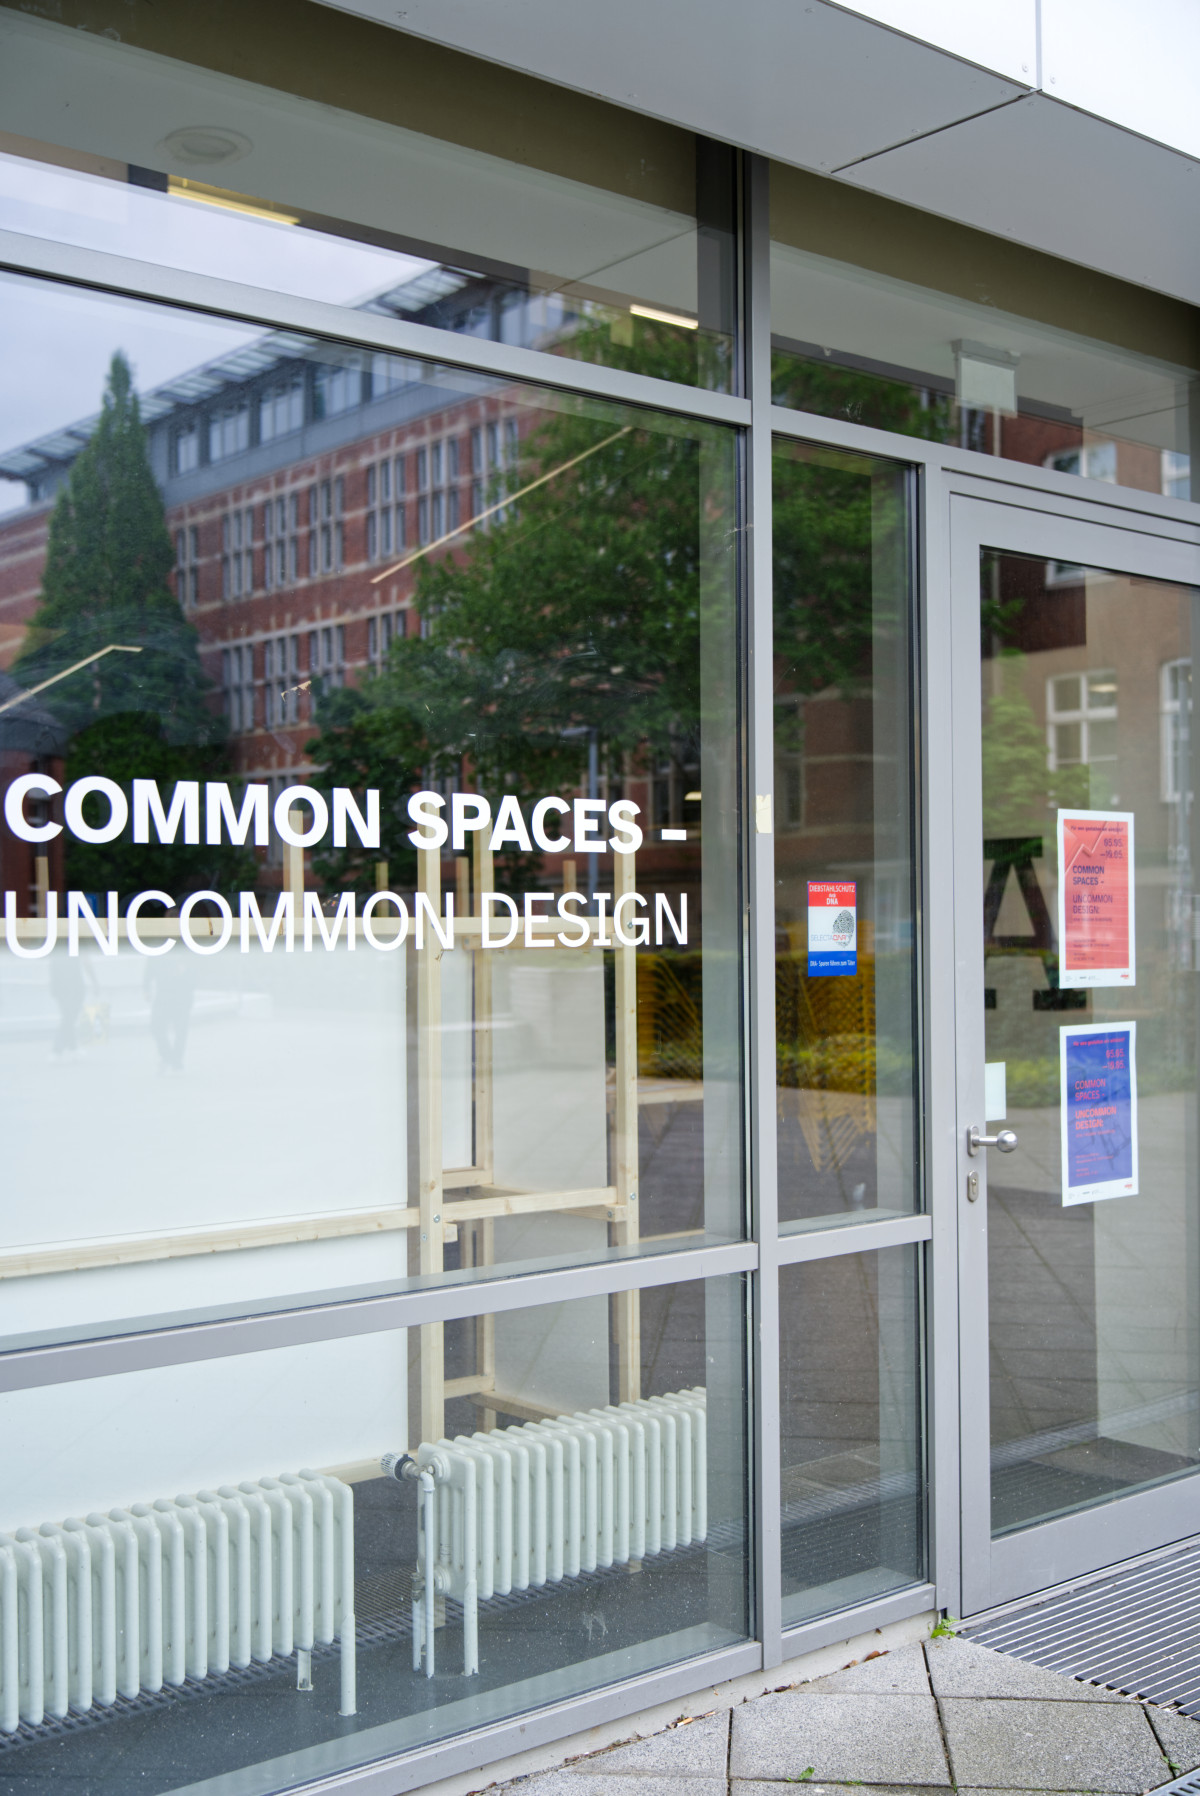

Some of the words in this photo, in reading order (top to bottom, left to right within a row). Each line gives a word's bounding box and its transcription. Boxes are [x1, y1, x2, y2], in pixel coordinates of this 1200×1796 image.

[3, 773, 381, 848] COMMON
[407, 790, 643, 854] SPACES
[1072, 865, 1105, 875] COMMON
[1072, 876, 1099, 886] SPACES
[809, 884, 855, 893] DIEBSTAHLSCHUTZ
[1072, 894, 1113, 904] UNCOMMON
[3, 890, 455, 959] UNCOMMON
[481, 892, 688, 949] DESIGN
[1074, 1078, 1106, 1090] COMMON
[1074, 1090, 1100, 1102] SPACES
[1075, 1106, 1117, 1119] UNCOMMON
